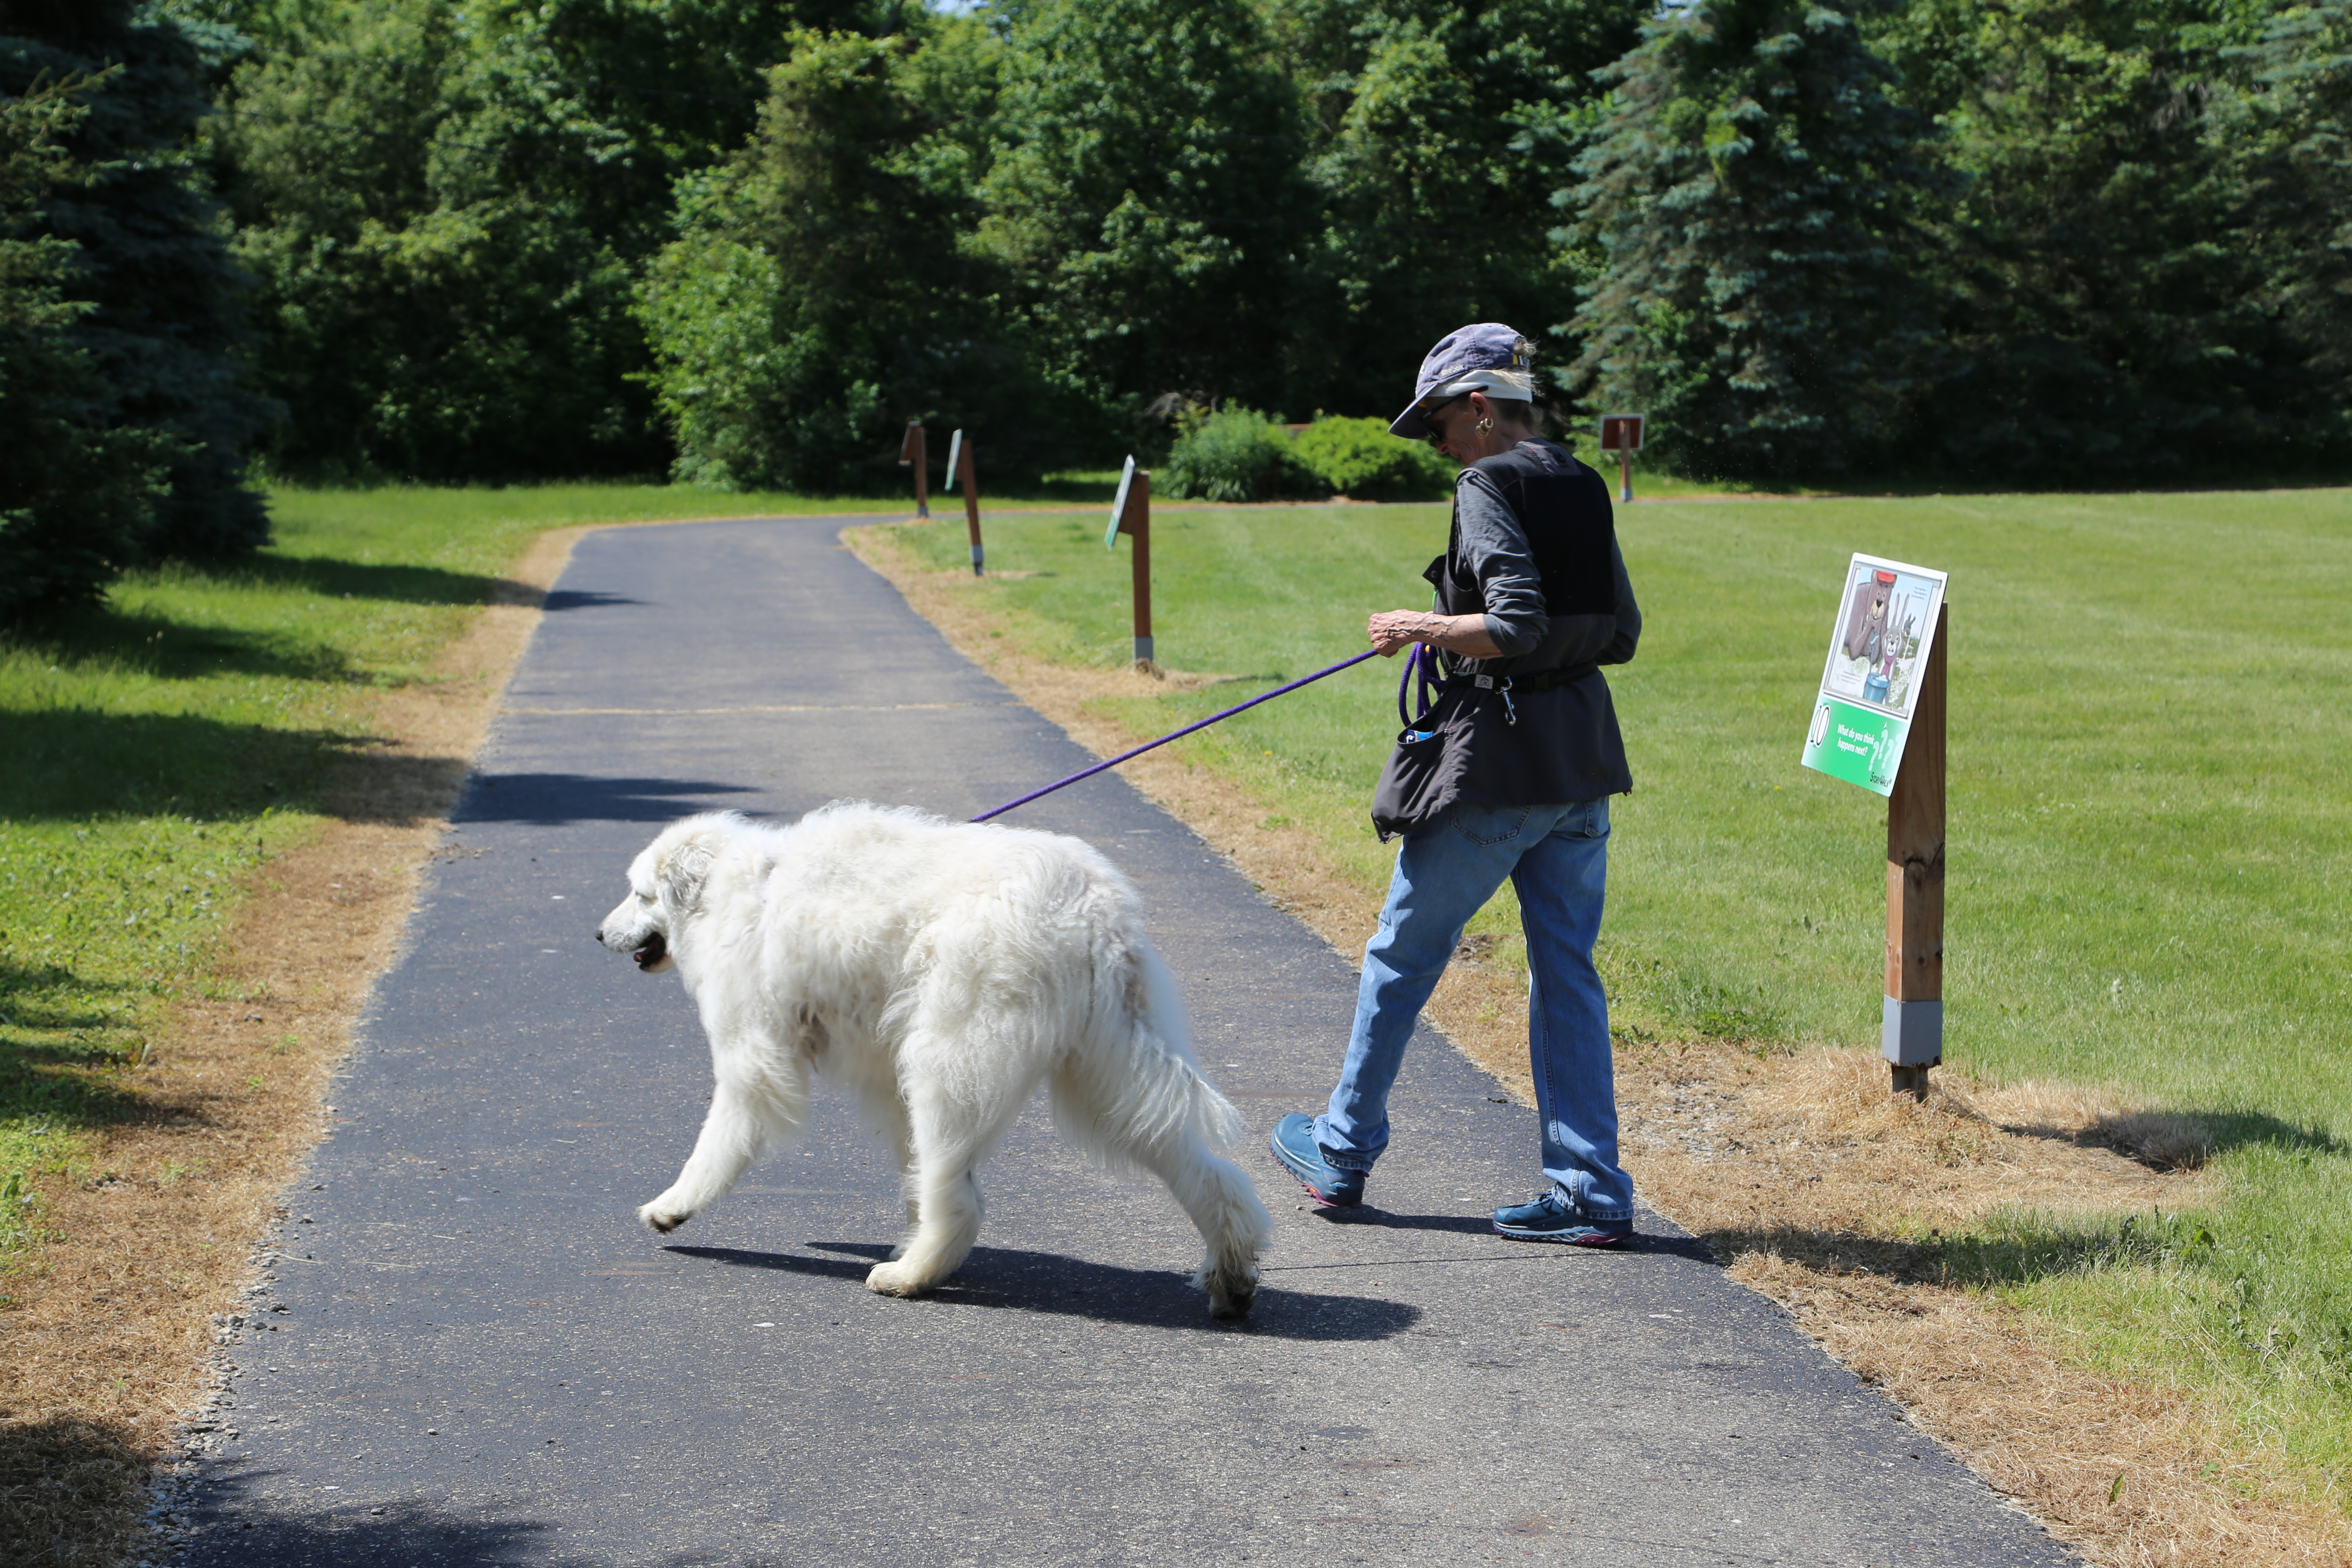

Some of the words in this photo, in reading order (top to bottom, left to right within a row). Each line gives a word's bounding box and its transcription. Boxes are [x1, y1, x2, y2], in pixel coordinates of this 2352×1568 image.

[1441, 364, 1464, 376] Reebok
[1810, 704, 1830, 747] 10
[1838, 723, 1849, 736] What
[1849, 727, 1855, 738] do
[1853, 732, 1863, 742] you
[1863, 732, 1874, 745] think
[1837, 736, 1855, 752] happens
[1855, 746, 1868, 756] next?
